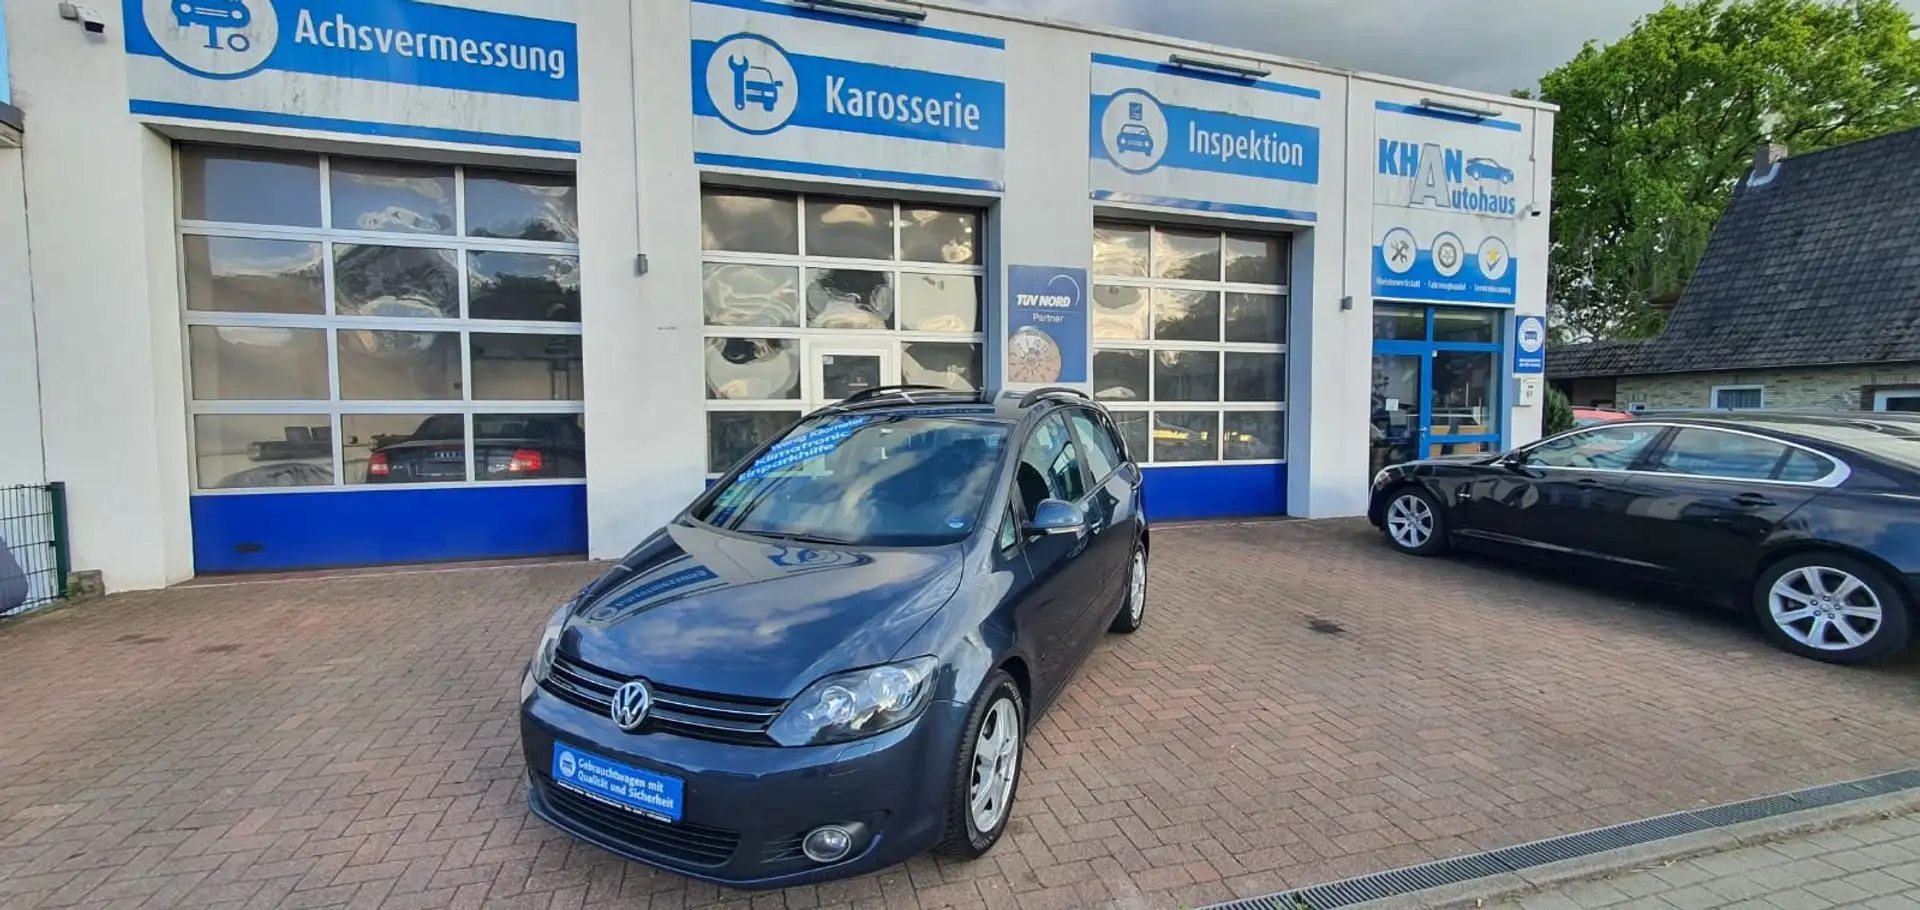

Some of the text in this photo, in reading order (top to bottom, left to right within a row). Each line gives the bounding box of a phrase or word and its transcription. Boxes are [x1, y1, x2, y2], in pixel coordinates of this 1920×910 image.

[295, 9, 566, 79] Achsvermessung
[825, 75, 981, 131] Karosserie
[1188, 120, 1304, 167] Inspektion
[1379, 138, 1463, 208] KHAN
[1032, 313, 1065, 324] Partner
[1039, 296, 1071, 308] NORD
[810, 418, 864, 438] Kilometer
[738, 443, 835, 482] Einparkhilfe
[754, 430, 850, 467] Klimatronic
[577, 758, 664, 793] Gebrauchtwagen mit
[577, 770, 609, 791] Qualität
[610, 784, 627, 796] und
[628, 786, 674, 809] Sicherheit
